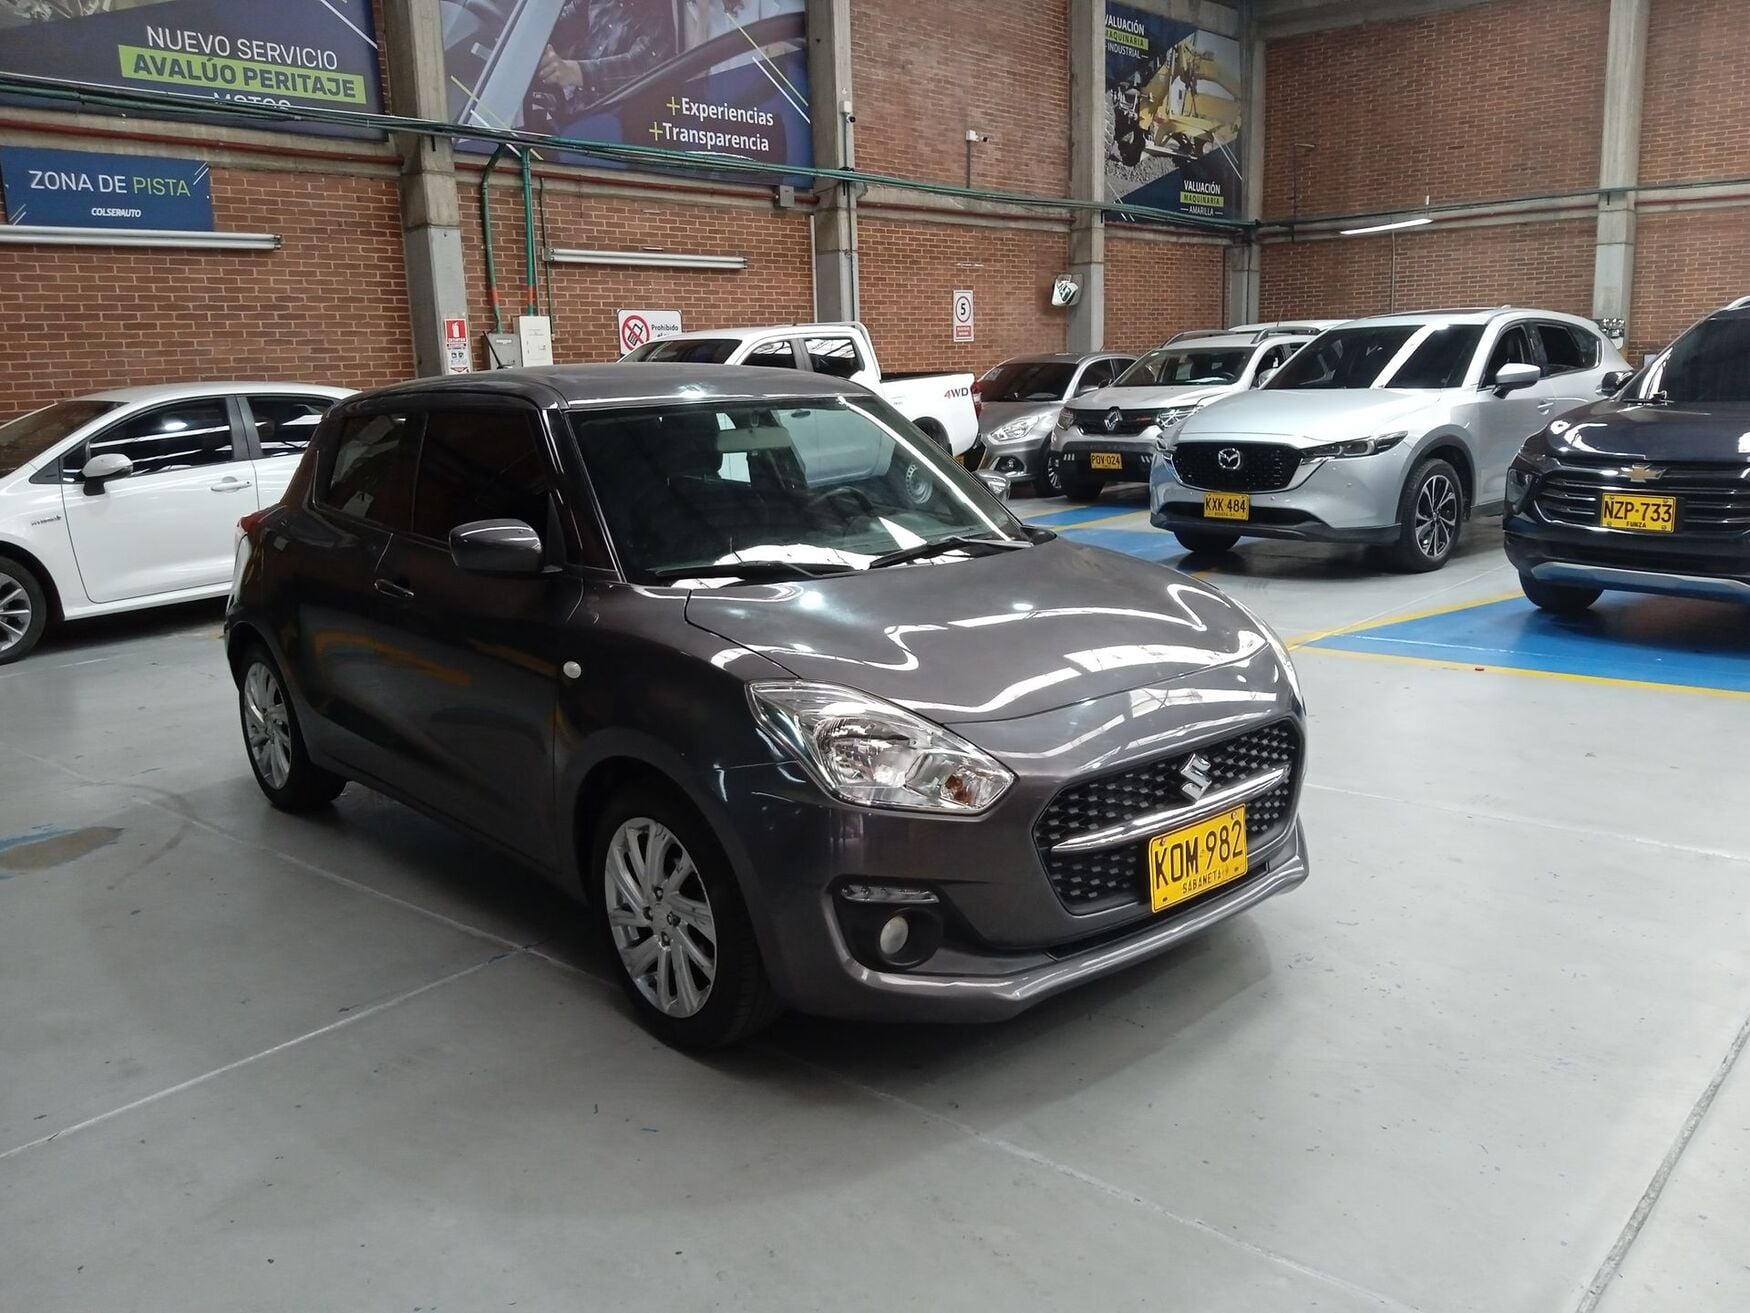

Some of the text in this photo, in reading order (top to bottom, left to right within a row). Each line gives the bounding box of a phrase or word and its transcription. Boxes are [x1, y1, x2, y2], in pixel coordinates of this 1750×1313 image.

[147, 25, 338, 70] NUEVO SERVICIO
[1108, 43, 1141, 59] INDUSTRIAL
[133, 53, 356, 98] AVALÚO PERITAJE
[28, 170, 191, 197] ZONA DE PISTA
[1184, 180, 1220, 195] VALUACIÓN
[1184, 194, 1220, 205] MAQUINARIA
[91, 207, 142, 218] COLSERAUTO
[1189, 206, 1214, 216] AMARILLA
[961, 303, 966, 315] 5
[944, 387, 969, 399] 4WD
[1227, 498, 1246, 513] 484
[1205, 819, 1243, 870] 982
